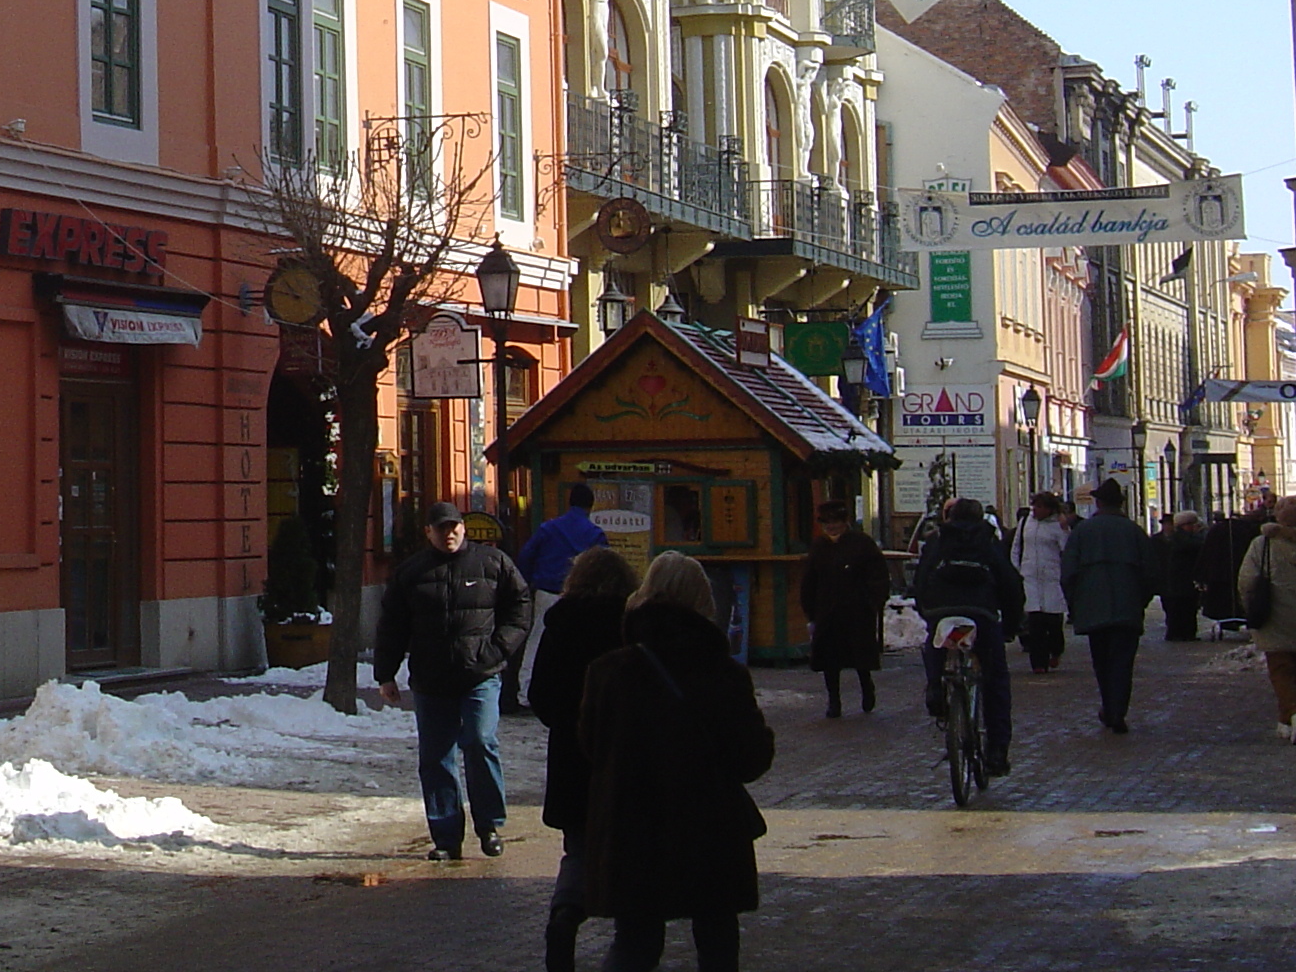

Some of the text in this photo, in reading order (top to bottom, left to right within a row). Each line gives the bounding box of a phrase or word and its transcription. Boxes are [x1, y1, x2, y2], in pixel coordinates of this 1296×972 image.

[971, 209, 1018, 237] A
[1016, 210, 1090, 236] család
[1090, 208, 1169, 242] bankja
[4, 209, 168, 277] EXPRESS
[110, 318, 186, 332] VISION EXPRESS
[902, 387, 984, 413] GRAND
[905, 415, 982, 425] TOURS
[589, 463, 652, 471] Az udvarban
[1111, 459, 1127, 470] dm
